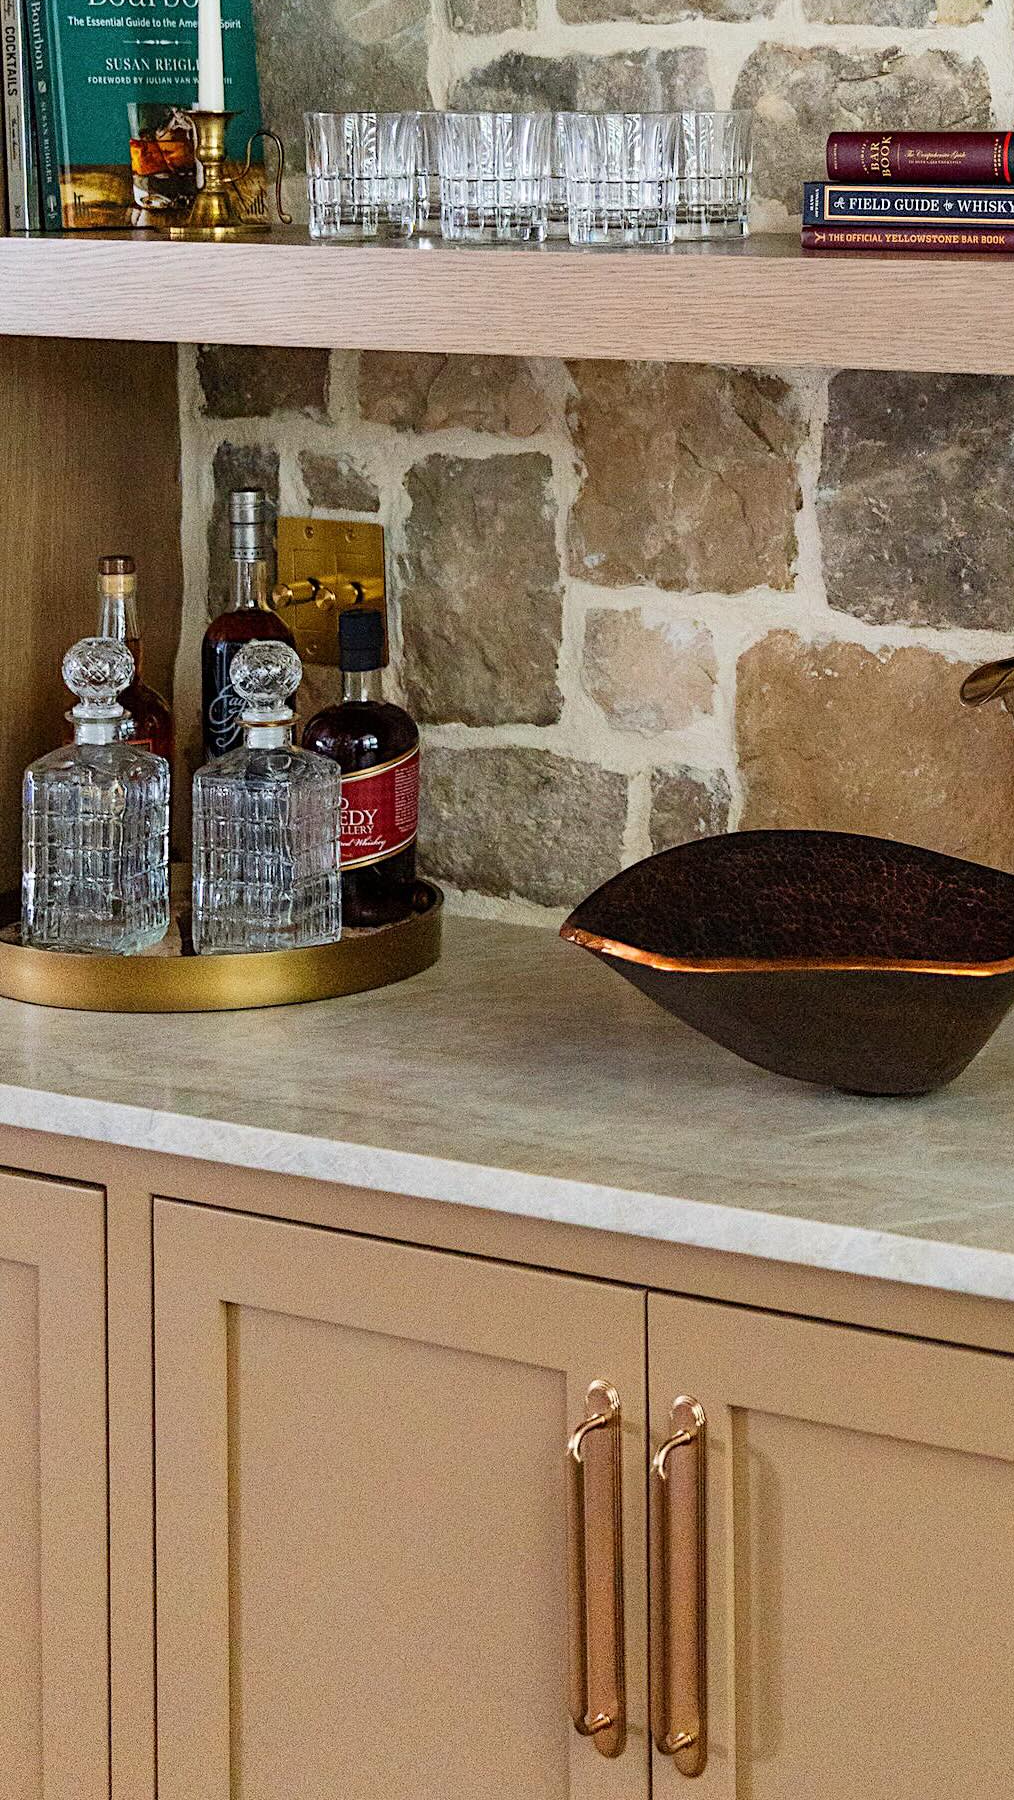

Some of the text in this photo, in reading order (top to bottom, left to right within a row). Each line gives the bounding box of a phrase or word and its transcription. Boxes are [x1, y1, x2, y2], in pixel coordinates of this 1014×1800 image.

[67, 15, 85, 26] The
[86, 16, 124, 28] Essential
[126, 16, 150, 28] Guide
[152, 17, 161, 28] to
[163, 17, 177, 28] the
[30, 1, 44, 71] Bourbon
[5, 26, 18, 97] COCKTAILS
[105, 57, 200, 72] SUSAN REIGL
[87, 76, 131, 85] FOREWORD
[133, 76, 143, 85] BY
[174, 76, 191, 85] VAN
[870, 142, 881, 171] BAR
[880, 136, 892, 177] BOOK
[849, 197, 891, 211] FIELD
[894, 198, 940, 212] GUIDE
[942, 199, 955, 212] to
[828, 233, 1006, 245] THE OFFICIAL YELLOWSTONE BAR BOOK
[340, 809, 378, 826] EDY
[341, 825, 375, 835] LLERY
